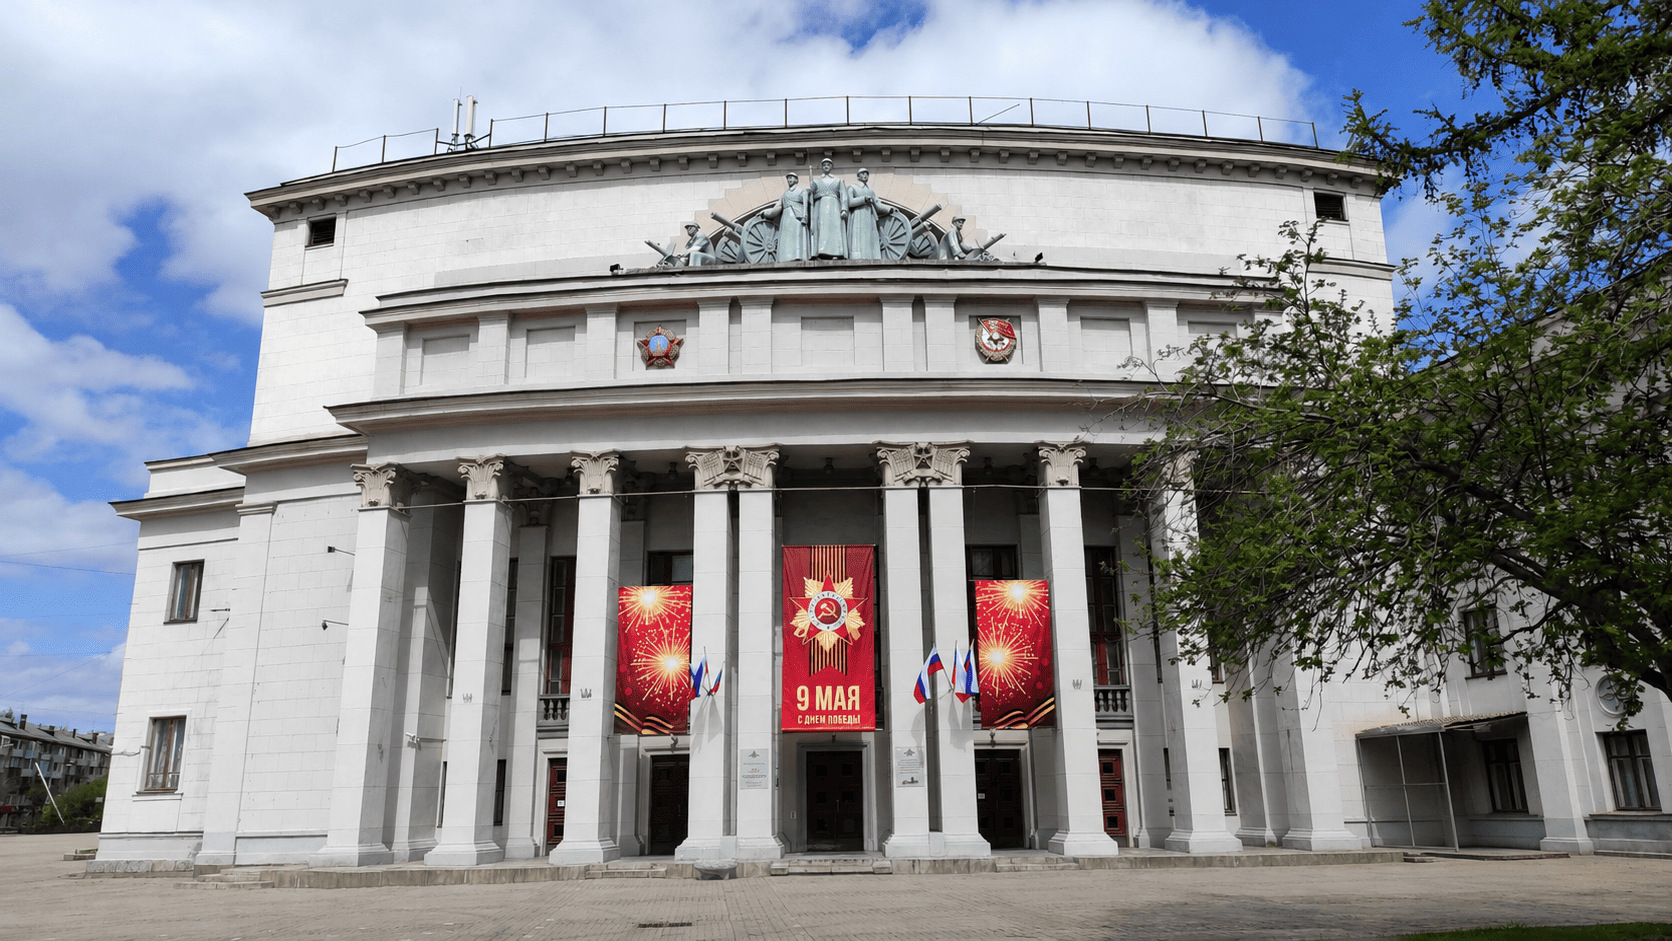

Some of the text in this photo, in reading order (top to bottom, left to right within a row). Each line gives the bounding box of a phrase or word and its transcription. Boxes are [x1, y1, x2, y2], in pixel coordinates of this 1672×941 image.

[797, 685, 860, 711] 9 МАЯ
[798, 715, 860, 725] С ДНЕМ ПОБЕДЫ
